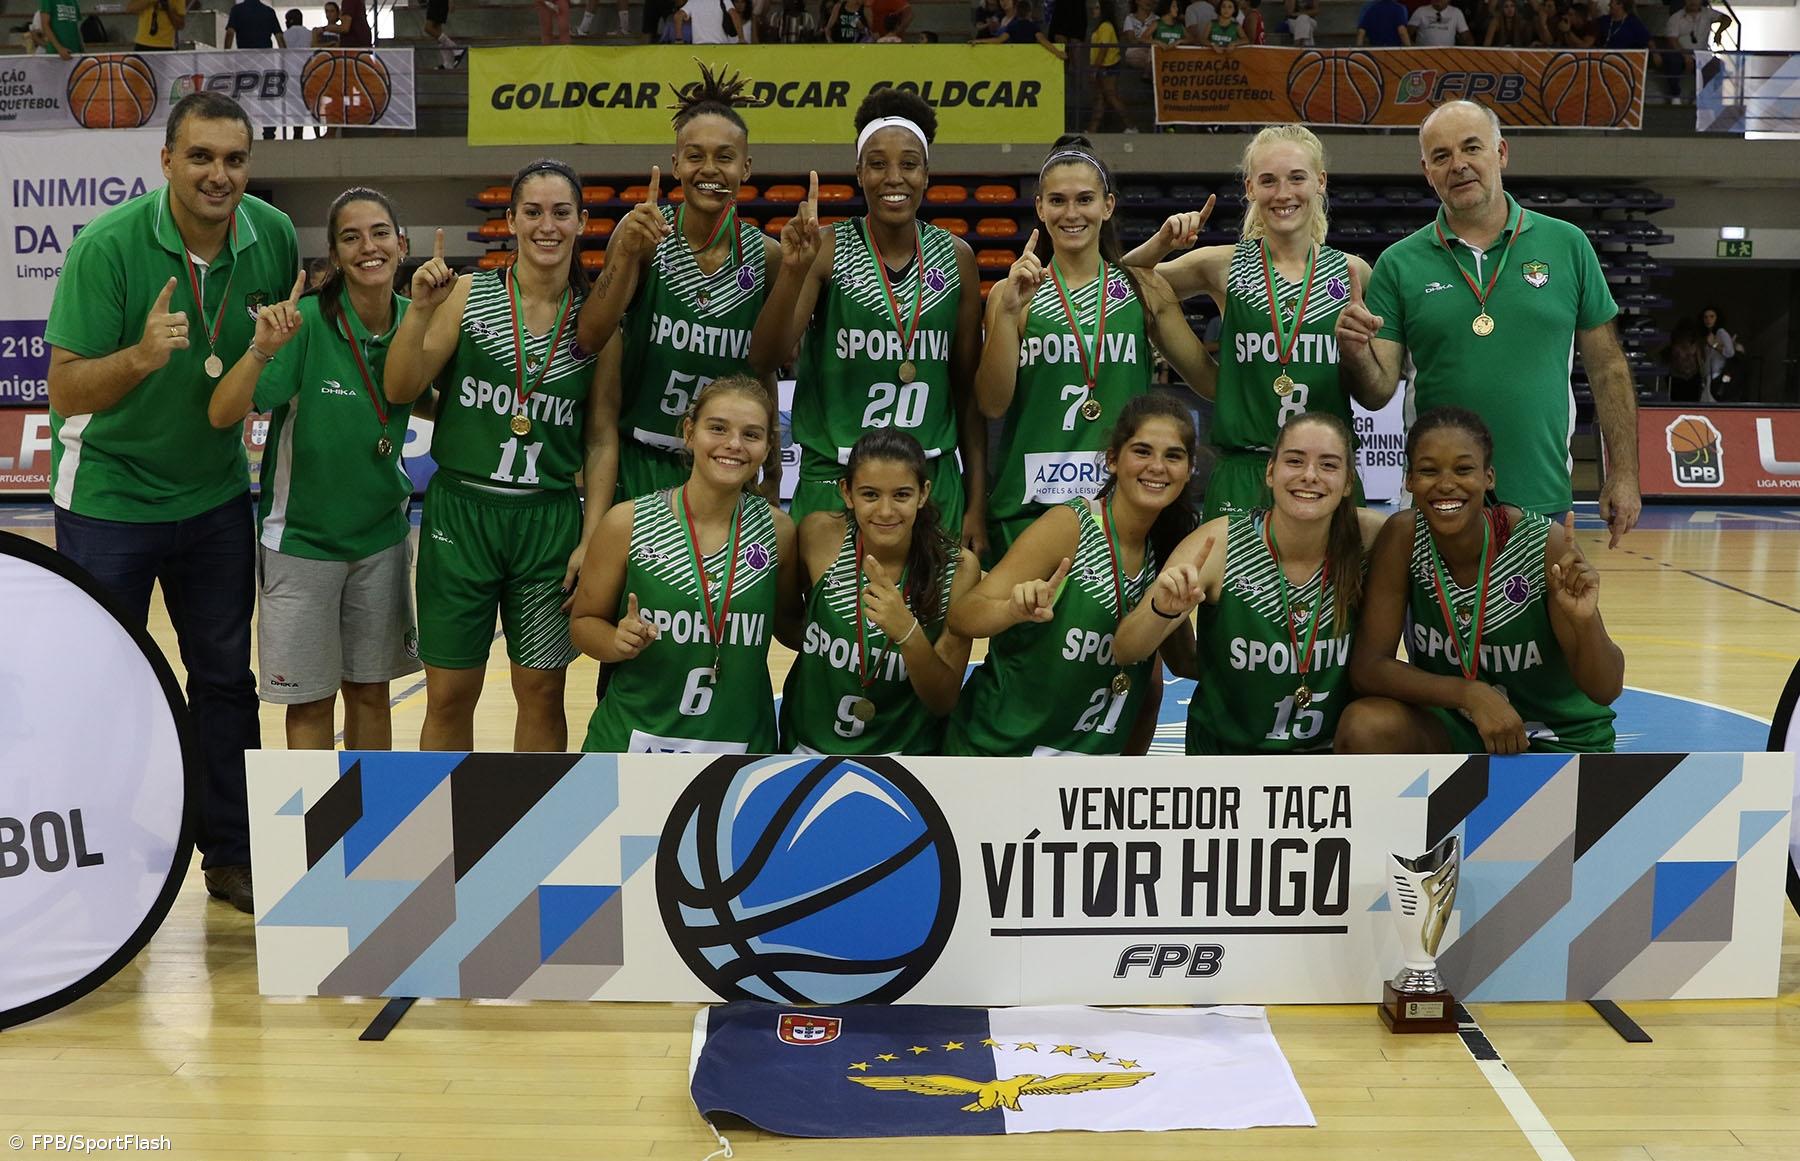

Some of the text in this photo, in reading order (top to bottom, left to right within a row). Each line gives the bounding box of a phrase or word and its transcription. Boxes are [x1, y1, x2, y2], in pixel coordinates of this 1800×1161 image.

[0, 69, 26, 84] ÇÃO
[1161, 57, 1241, 73] FEDERAÇÃO
[1161, 74, 1249, 87] PORTUGUESA
[204, 69, 289, 100] FPB
[491, 81, 661, 110] GOLDCAR
[1162, 88, 1276, 101] DE BASQUETEBOL
[1432, 71, 1527, 103] FPB
[13, 177, 147, 208] INIMIGA
[15, 225, 62, 254] DA
[2, 335, 45, 358] 218
[836, 327, 949, 362] SPORTIVA
[1020, 332, 1137, 367] SPORIVA
[321, 387, 357, 396] DHIKA
[861, 381, 930, 428] 20
[1060, 384, 1089, 431] 7
[1277, 383, 1310, 428] 8
[490, 437, 543, 484] 11
[1679, 466, 1717, 481] LPB
[1036, 487, 1066, 495] HOTELS
[1757, 480, 1778, 488] LIGA
[1414, 623, 1543, 673] SPOTIVA
[678, 667, 717, 716] 6
[833, 695, 866, 738] 9
[1072, 687, 1129, 735] 21
[1265, 691, 1330, 741] 15
[1059, 785, 1352, 833] VENCEDOR TAÇA
[0, 808, 105, 879] BOL
[980, 828, 1352, 919] VÍTOR HUGO
[1112, 943, 1226, 979] FPB
